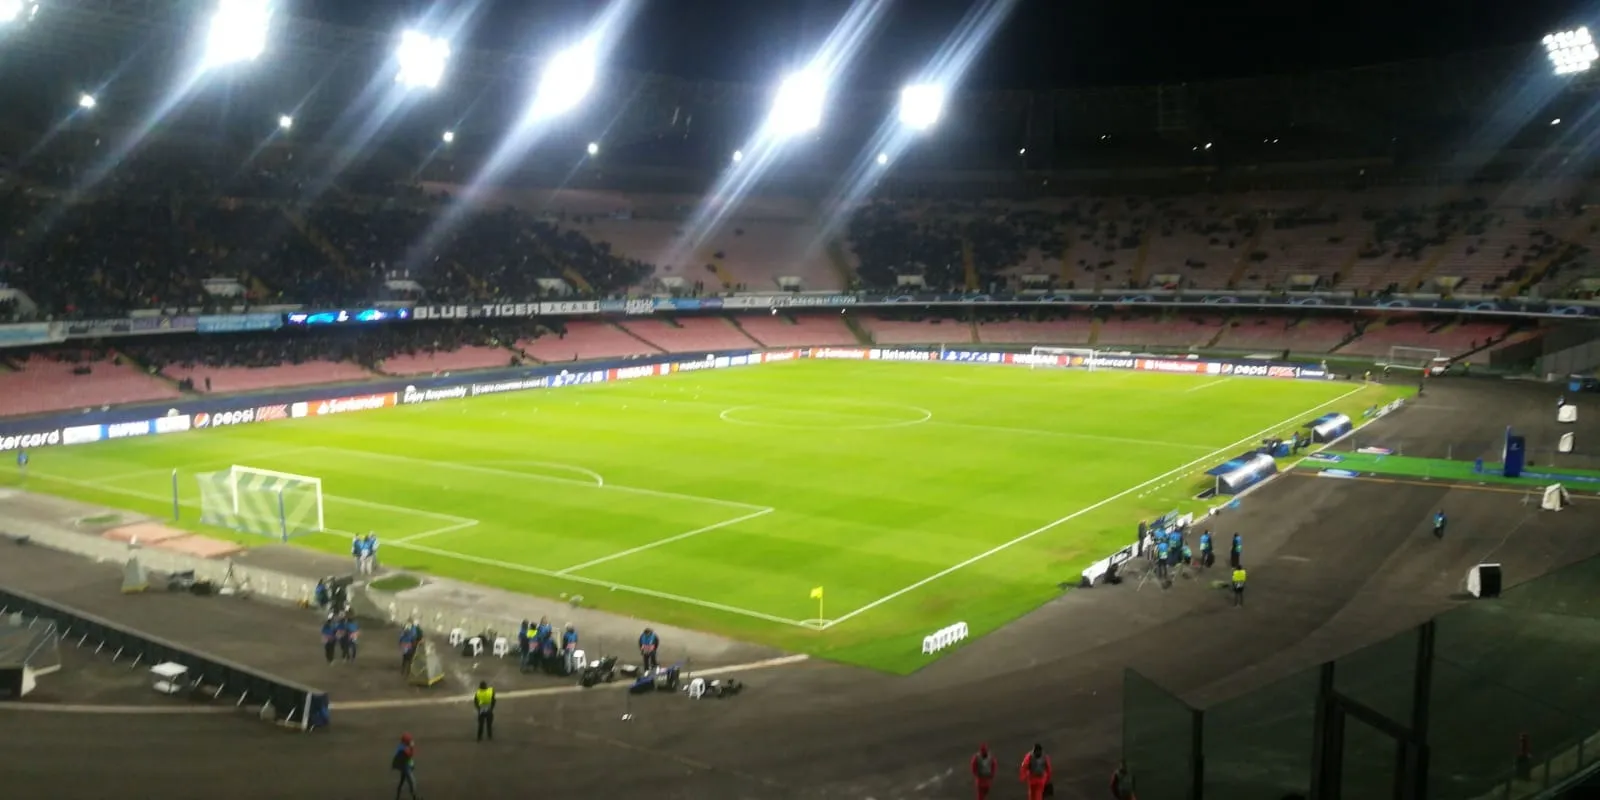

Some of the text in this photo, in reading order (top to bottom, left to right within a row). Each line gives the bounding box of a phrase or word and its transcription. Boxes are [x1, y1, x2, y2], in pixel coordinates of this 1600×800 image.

[413, 303, 540, 319] BLUE TIGER
[882, 349, 929, 361] Heineken
[1234, 365, 1268, 376] pepsi
[212, 408, 254, 427] pepsi
